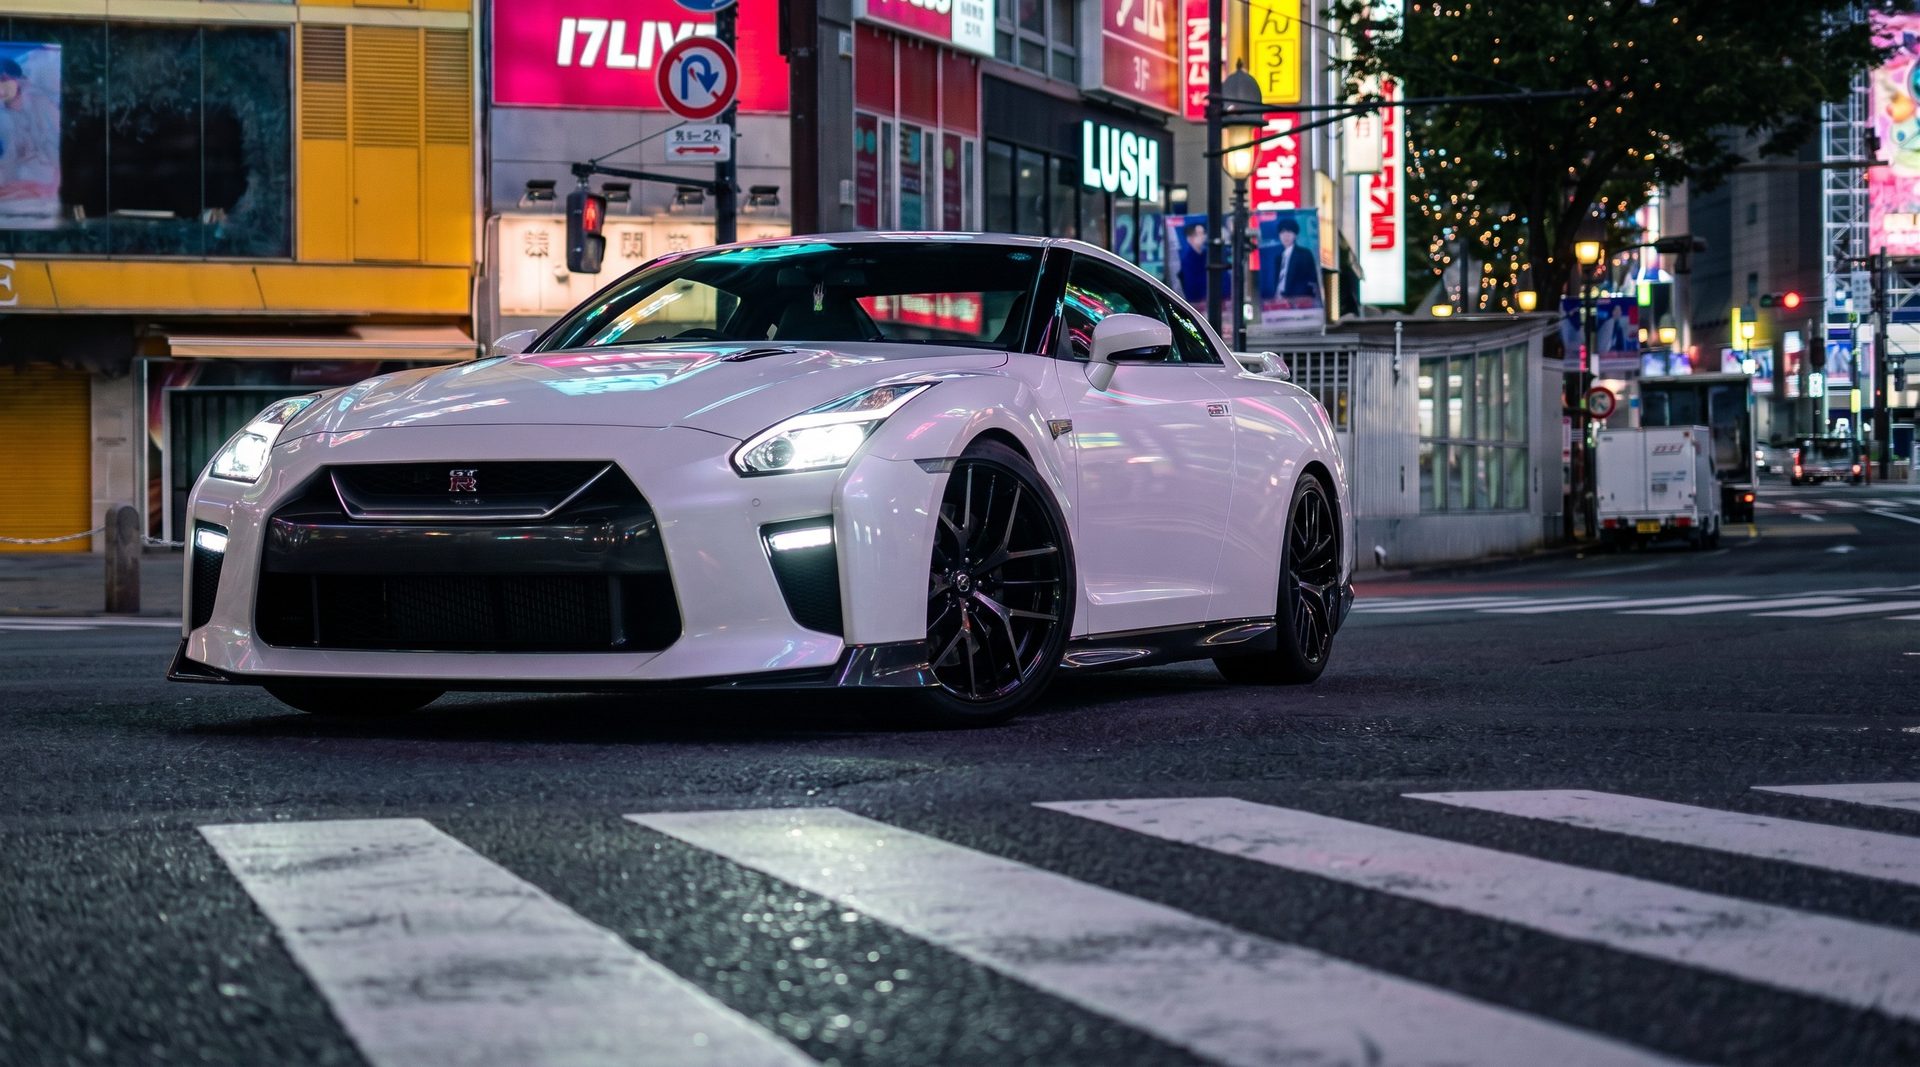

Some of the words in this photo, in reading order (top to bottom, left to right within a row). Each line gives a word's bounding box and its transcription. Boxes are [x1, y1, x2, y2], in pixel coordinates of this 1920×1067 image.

[1083, 120, 1159, 203] LUSH
[1255, 118, 1297, 210] スギ
[1114, 213, 1164, 262] 24
